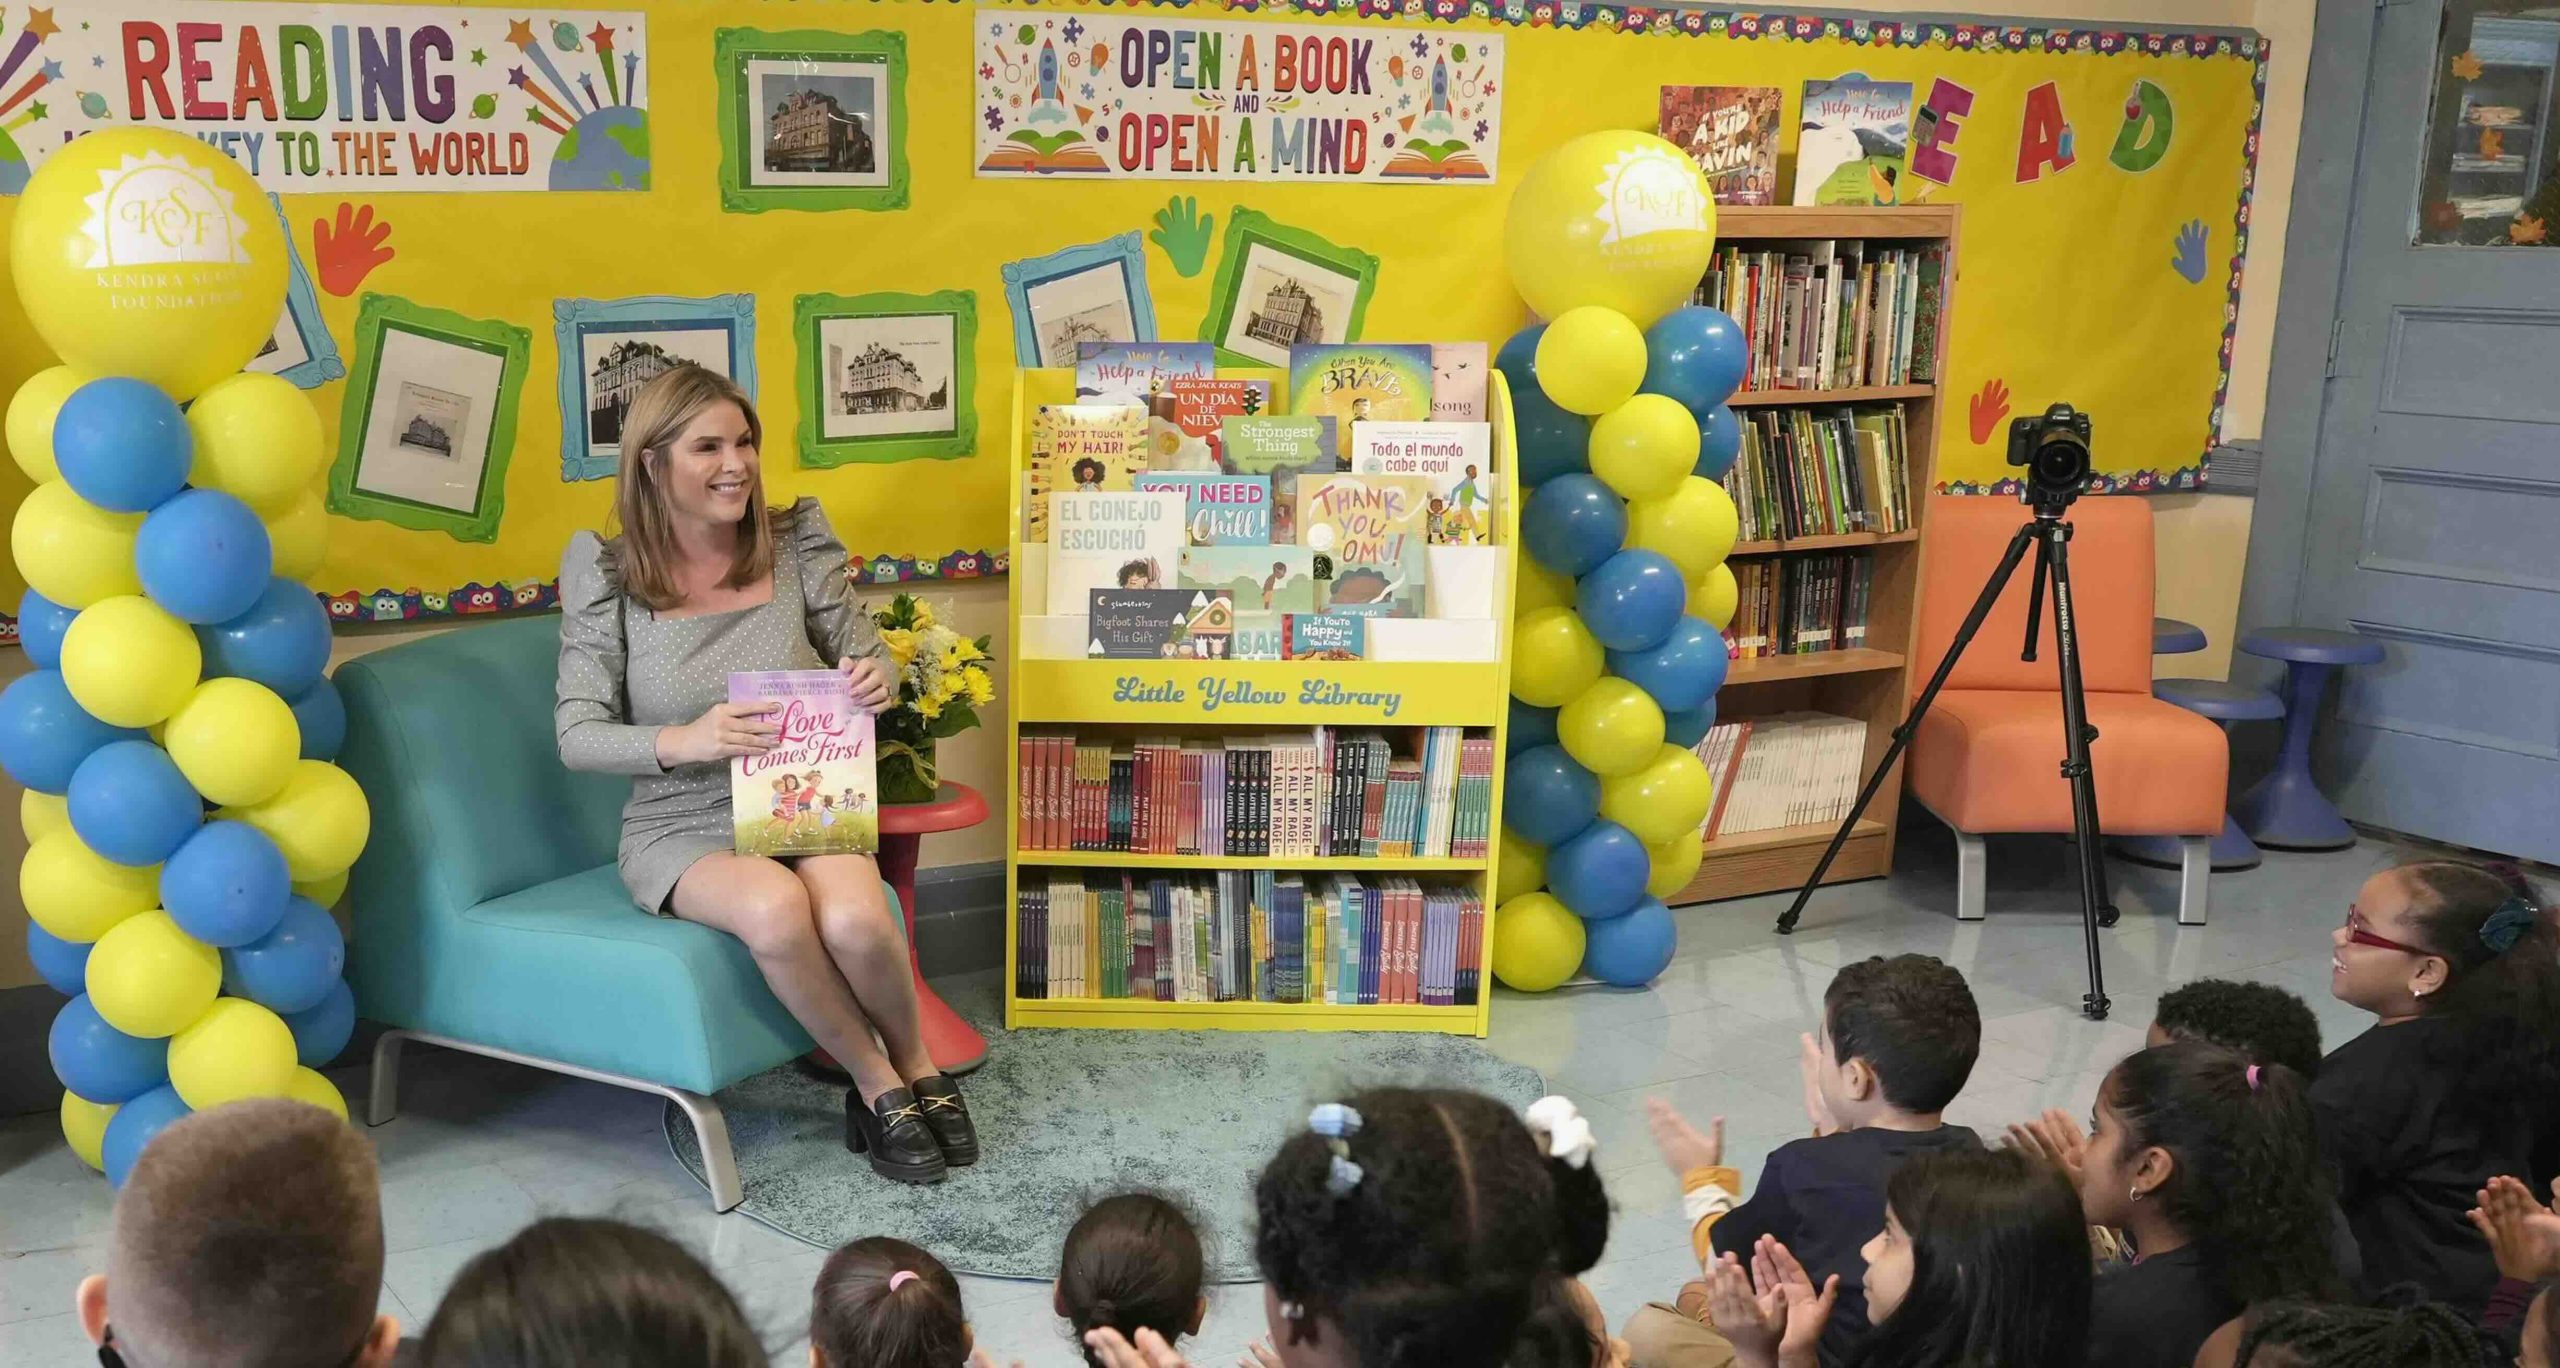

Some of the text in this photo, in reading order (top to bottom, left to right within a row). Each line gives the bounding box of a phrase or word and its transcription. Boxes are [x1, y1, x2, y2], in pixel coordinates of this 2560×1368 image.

[121, 21, 456, 123] READING
[1120, 28, 1374, 95] OPEN A BOOK
[1233, 95, 1260, 113] AND
[1821, 100, 1905, 121] Help a Friend
[1692, 111, 1750, 146] A KID
[276, 132, 321, 176] TO
[332, 131, 397, 175] THE
[409, 131, 530, 176] WORLD
[1118, 112, 1370, 175] OPEN A MIND
[121, 185, 213, 248] KSF
[96, 272, 184, 288] KENDRA
[111, 289, 243, 309] FOUNDATION
[1096, 361, 1134, 385] Help
[1151, 361, 1206, 381] Friend
[1358, 356, 1375, 368] You
[1321, 367, 1402, 396] BRAVE
[1180, 391, 1237, 405] UN DÍA
[1430, 398, 1472, 416] song
[1200, 406, 1216, 414] DE
[1057, 430, 1124, 439] DON'T TOUCH
[1241, 424, 1316, 440] Strongest
[1057, 441, 1124, 454] MY HAIR!
[1253, 438, 1298, 455] Thing
[1371, 442, 1463, 457] Todo el mundo
[1386, 457, 1449, 474] cabe aquí
[1199, 482, 1263, 504] NEED
[1313, 485, 1404, 521] THANK
[1060, 500, 1162, 522] EL CONEJO
[1192, 508, 1266, 541] Chill!
[1060, 525, 1146, 550] ESCUCHÓ
[1343, 533, 1405, 566] OMU!
[1096, 614, 1169, 630] Bigfoot Shares
[1302, 623, 1343, 640] Happy
[1313, 617, 1321, 625] If
[1113, 631, 1155, 643] His Gift
[1113, 677, 1402, 716] Little Yellow Library
[769, 700, 834, 744] Love
[808, 729, 864, 767] First
[1272, 775, 1283, 844] ALL MY RAGE
[1287, 775, 1298, 844] ALL MY RAGE
[1302, 775, 1313, 844] ALL MY RAGE
